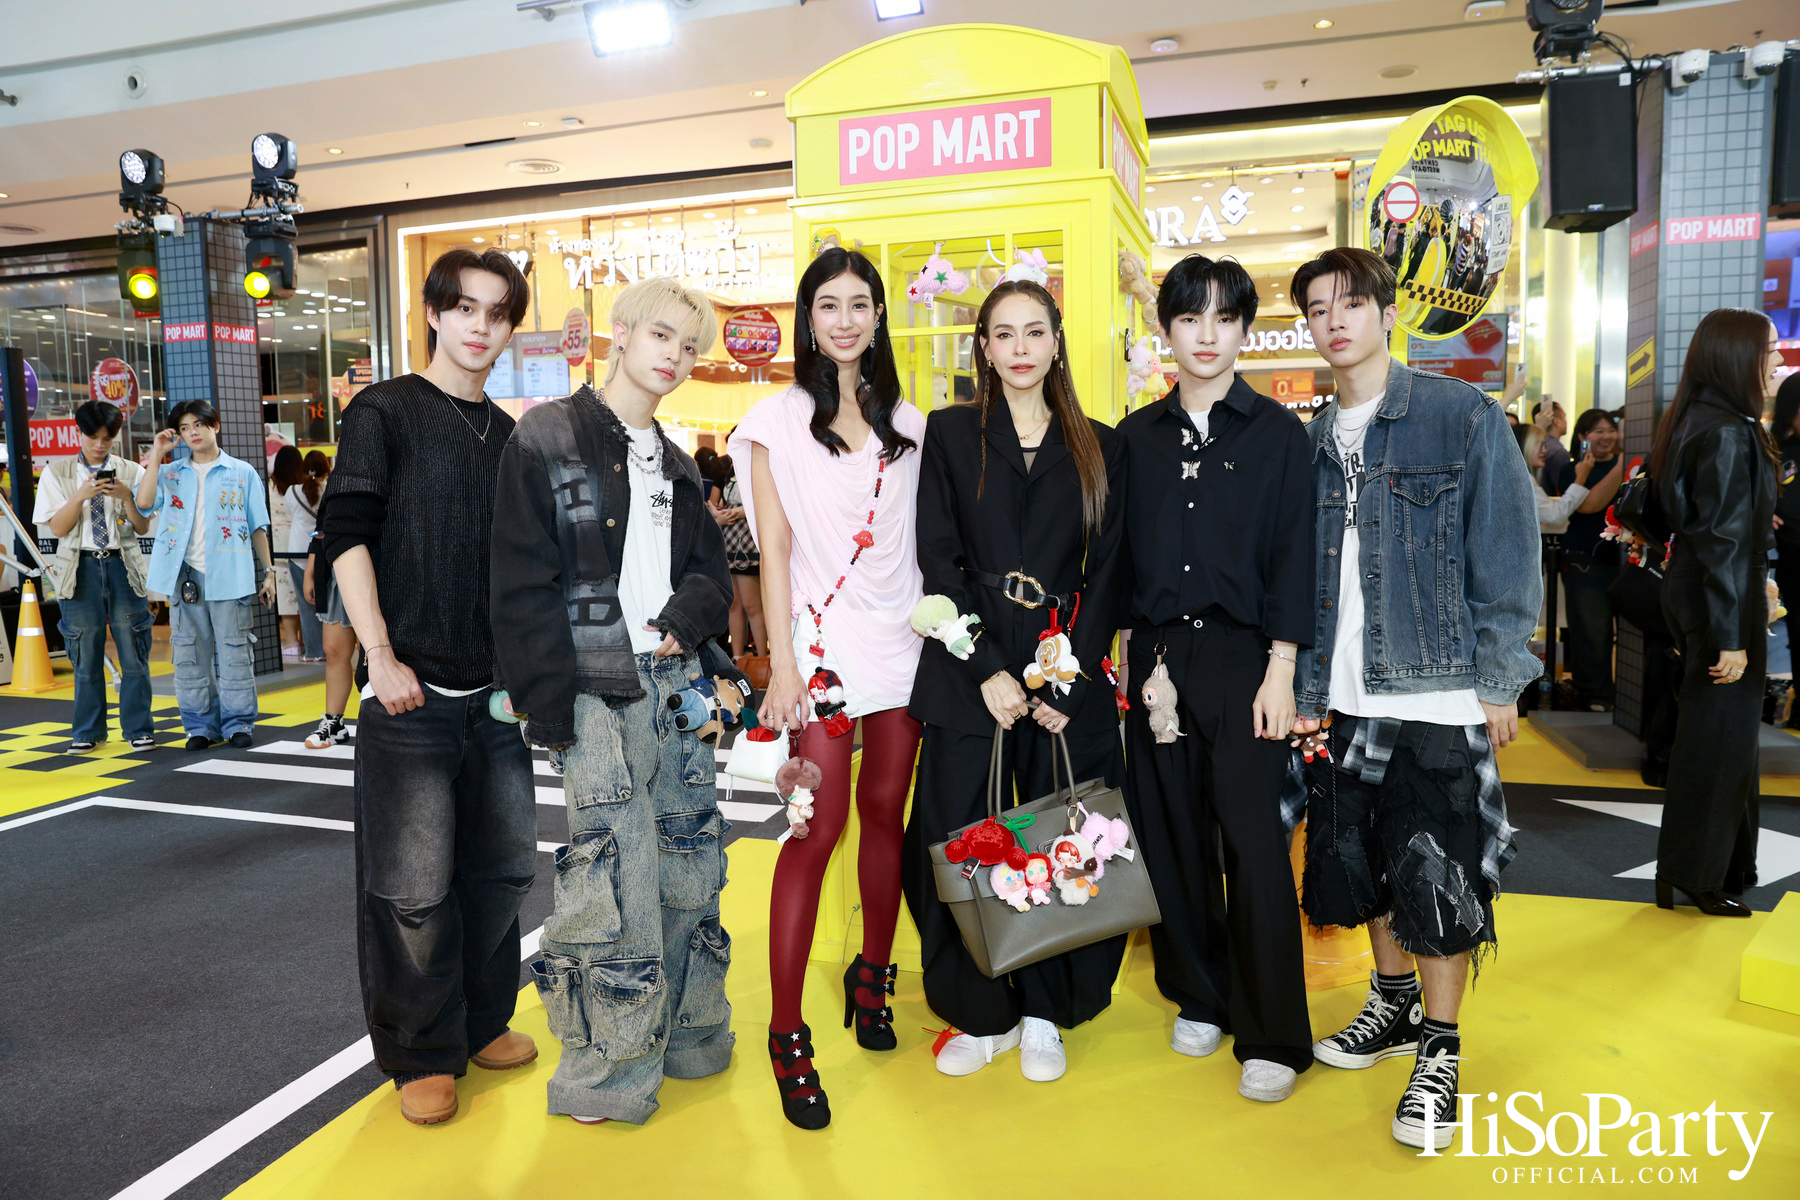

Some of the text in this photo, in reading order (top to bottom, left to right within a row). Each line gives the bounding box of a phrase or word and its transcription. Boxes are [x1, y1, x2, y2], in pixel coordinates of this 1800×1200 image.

[1435, 114, 1487, 143] TAG US
[849, 109, 1041, 175] POP MART
[1113, 122, 1124, 180] POP
[1411, 140, 1431, 162] OP
[1432, 138, 1471, 158] MART
[1669, 217, 1756, 241] POP MART
[165, 324, 206, 341] POP MART
[214, 325, 255, 343] POP MART
[105, 379, 127, 398] 40%
[30, 425, 82, 448] POP MA
